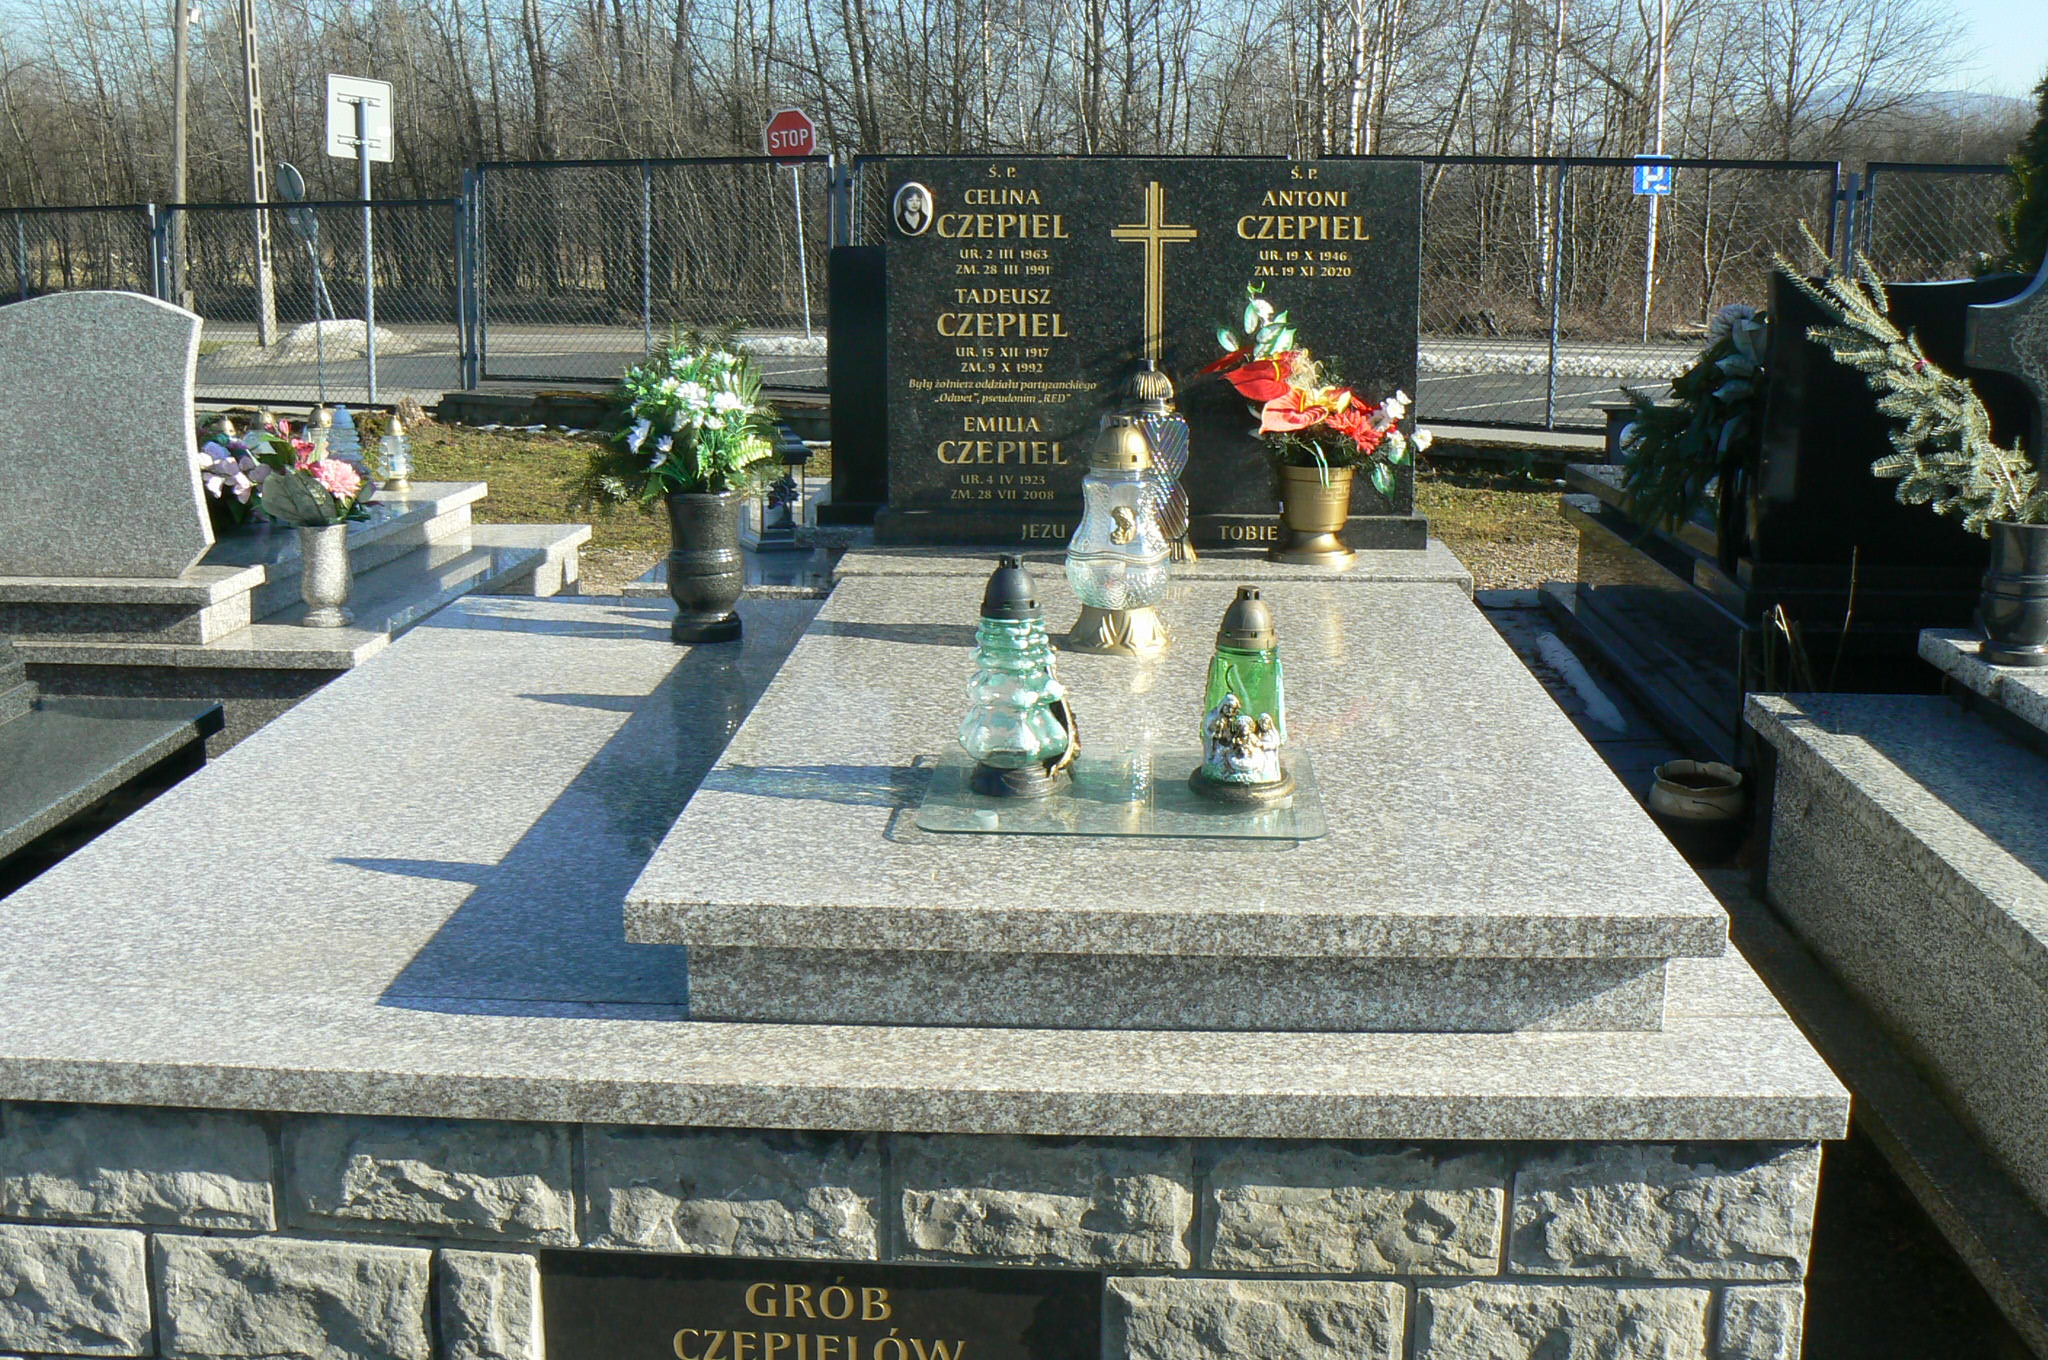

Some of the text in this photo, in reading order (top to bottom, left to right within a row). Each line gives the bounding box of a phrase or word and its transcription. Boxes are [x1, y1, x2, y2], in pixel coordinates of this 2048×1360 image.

[770, 128, 809, 149] STOP
[1006, 167, 1017, 178] P.
[1308, 169, 1318, 180] P.
[964, 188, 1041, 205] CELINA
[1262, 191, 1348, 207] ANTONI
[936, 214, 1070, 239] CZEPIEL
[1237, 216, 1370, 241] CZEPIEL
[959, 249, 1049, 260] UR. 2 III 1963
[1259, 251, 1348, 262] UR. 19 X 1946
[955, 265, 1051, 276] ZM. 28 III 1991
[1254, 266, 1351, 277] ZM. 19 XI 2020
[954, 288, 1051, 305] TADEUSZ
[936, 313, 1068, 338] CZEPIEL
[955, 347, 1049, 358] UR. 15 XII 1917
[960, 363, 1044, 374] ZM. 9 X 1992
[908, 379, 1097, 391] Były żołnierz oddziału partyzanckiego
[981, 394, 1036, 404] pseudonim
[963, 416, 1041, 432] EMILIA
[936, 440, 1068, 465] CZEPIEL
[960, 474, 1046, 485] UR. 4 IV 1923
[951, 489, 1055, 500] ZM. 28 VII 2008
[1021, 523, 1278, 541] JEZU TOBIE
[745, 1276, 892, 1321] GRÓB
